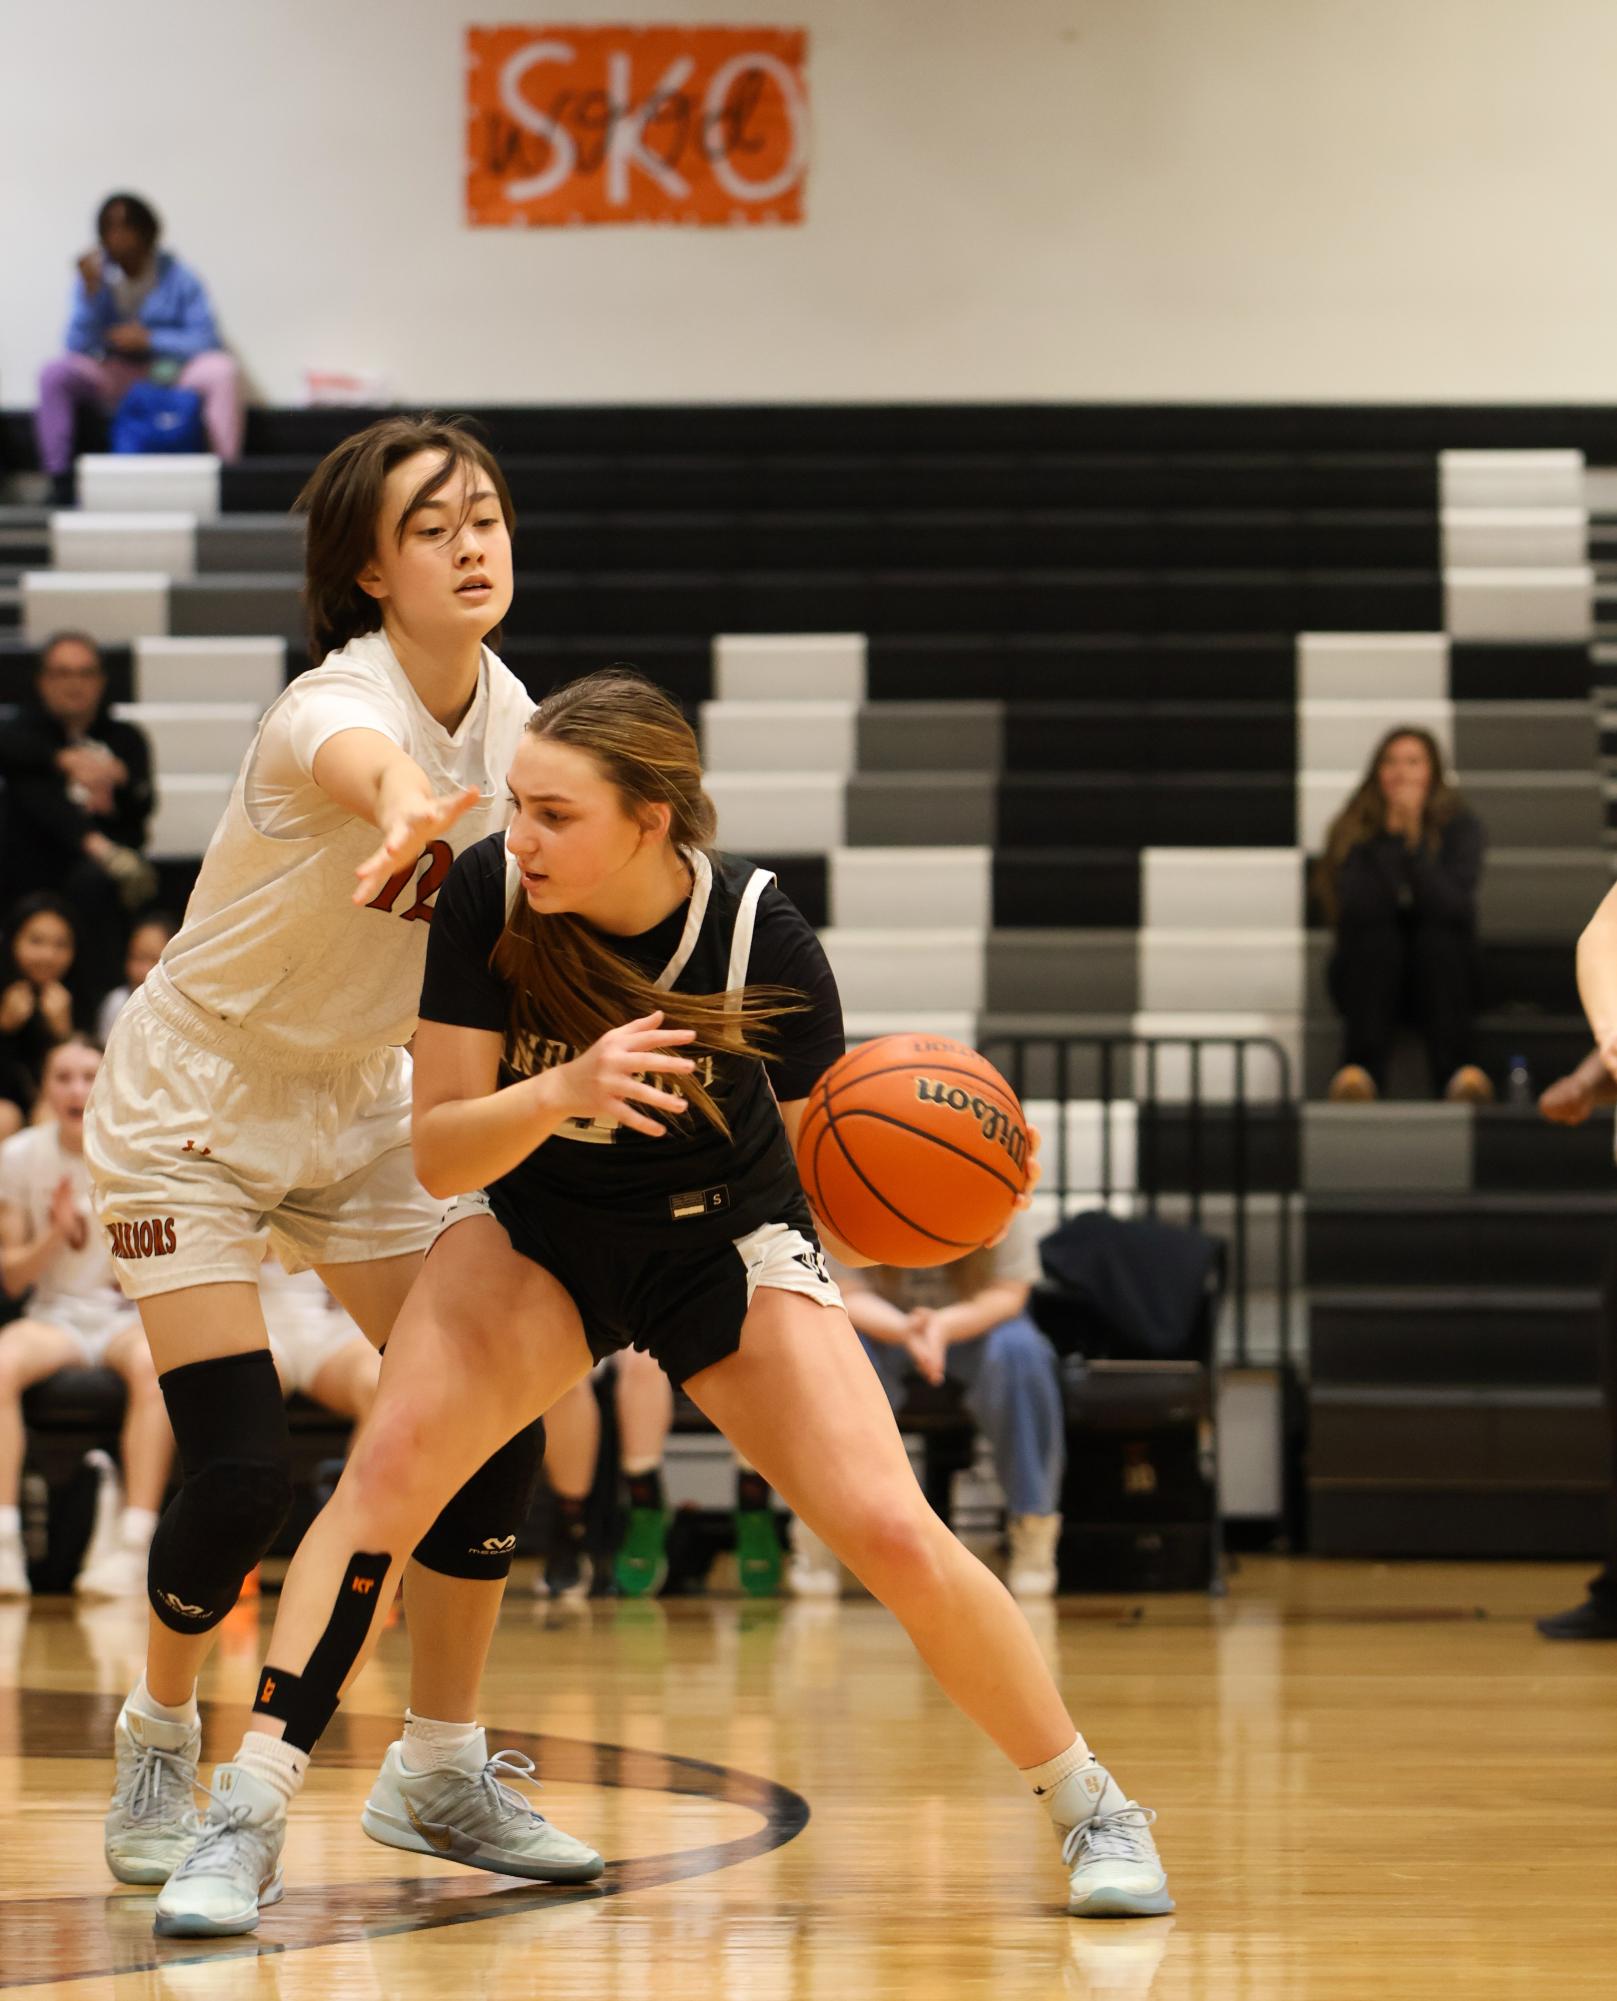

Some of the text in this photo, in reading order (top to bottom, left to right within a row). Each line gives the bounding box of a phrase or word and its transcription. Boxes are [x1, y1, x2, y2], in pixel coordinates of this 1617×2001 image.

[499, 38, 809, 206] SKO
[365, 839, 454, 925] 12
[913, 1075, 1026, 1173] Wilson
[712, 1193, 722, 1205] S
[352, 1576, 374, 1594] KT
[261, 1677, 276, 1703] KT
